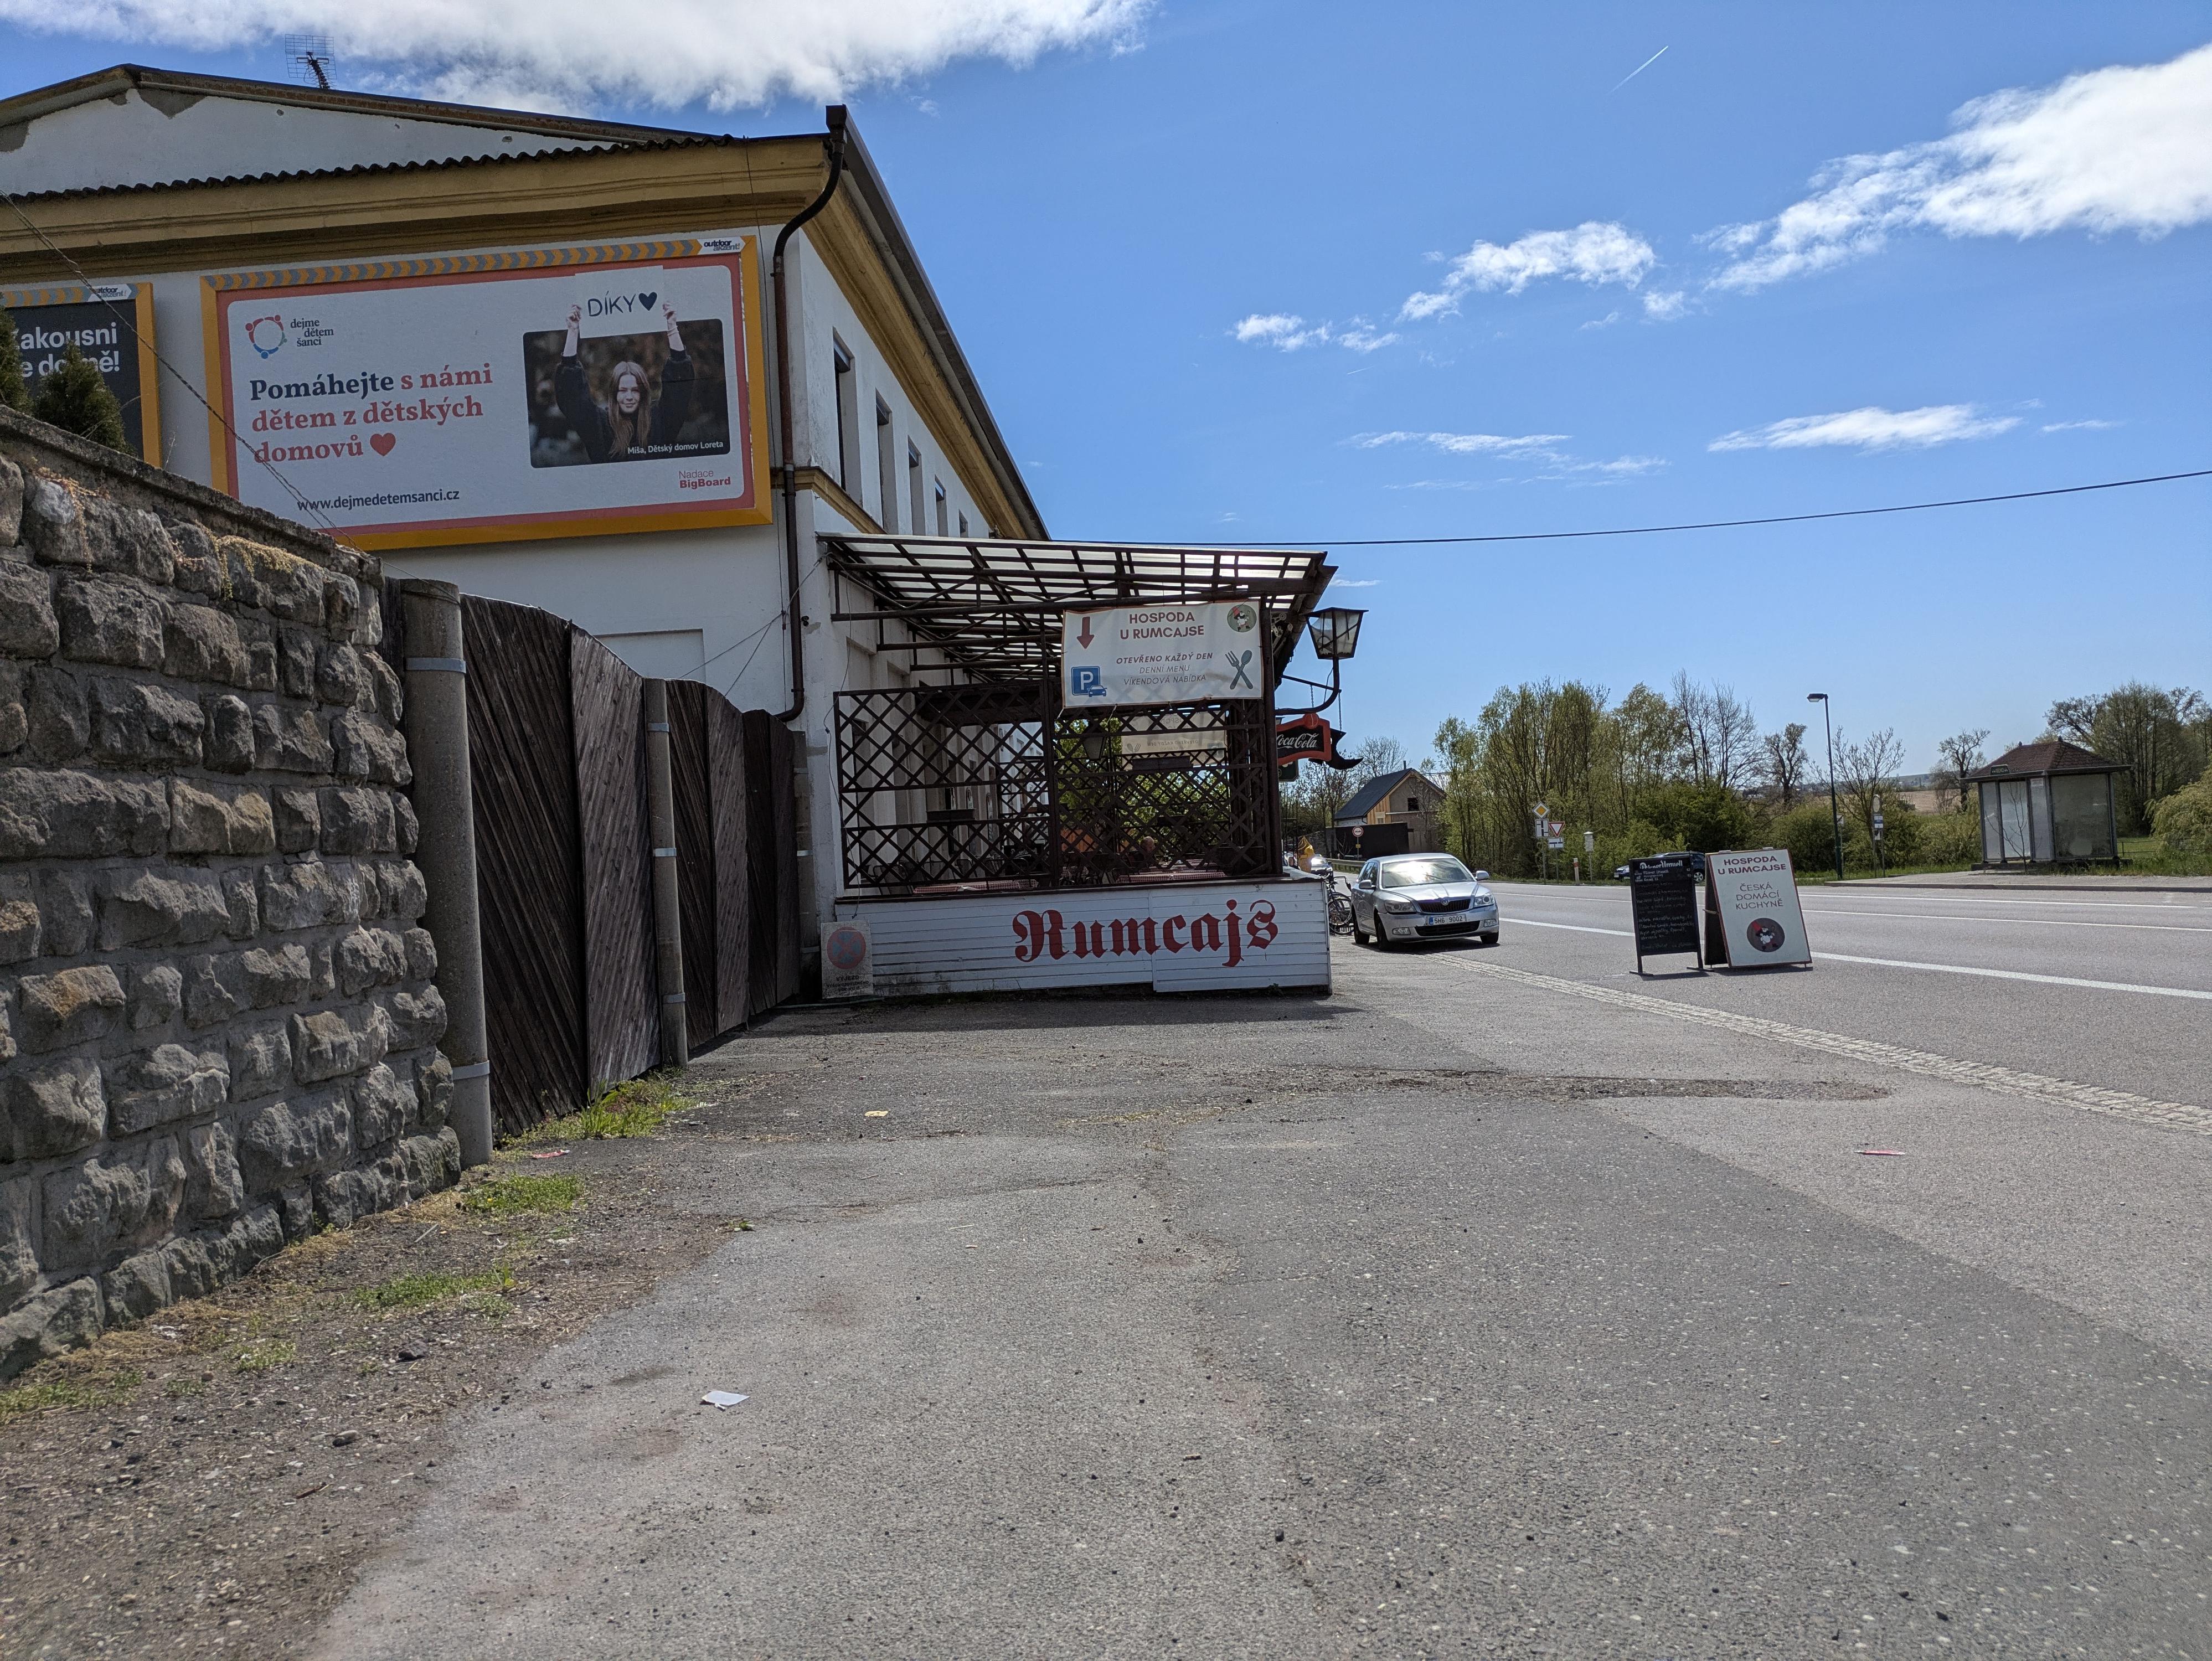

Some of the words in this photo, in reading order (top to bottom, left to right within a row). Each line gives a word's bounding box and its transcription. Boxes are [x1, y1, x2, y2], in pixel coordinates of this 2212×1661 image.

[587, 290, 636, 317] DÍKY
[290, 318, 320, 329] dejme
[304, 328, 334, 337] dětem
[297, 337, 322, 347] šanci
[250, 372, 394, 401] Pomáhejte
[401, 374, 413, 390] s
[420, 363, 493, 389] námi
[251, 408, 337, 432] dětem
[343, 410, 357, 426] z
[363, 395, 483, 426] dětských
[254, 434, 363, 463] domovů
[648, 445, 673, 453] Dětský
[679, 470, 713, 479] Nadace
[679, 477, 731, 489] BigBoard
[297, 489, 460, 511] www.dejmedetemsanci.cz
[1129, 611, 1195, 624] HOSPODA
[1120, 629, 1129, 639] U
[1133, 625, 1204, 639] RUMCAJSE
[1116, 654, 1162, 664] OTEVŘENO
[1165, 652, 1194, 662] KAŽDÝ
[1139, 664, 1165, 674] DENNÍ
[1124, 675, 1170, 685] VÍKENDOVÁ
[1173, 674, 1206, 683] NABÍDKA
[1724, 855, 1777, 865] HOSPODA
[1728, 863, 1786, 874] RUMCAJSE
[1740, 881, 1772, 891] ČESKÁ
[1736, 890, 1780, 901] DOMÁCÍ
[1735, 898, 1783, 910] KUCHYNĚ
[1012, 899, 1278, 967] Rumcajs
